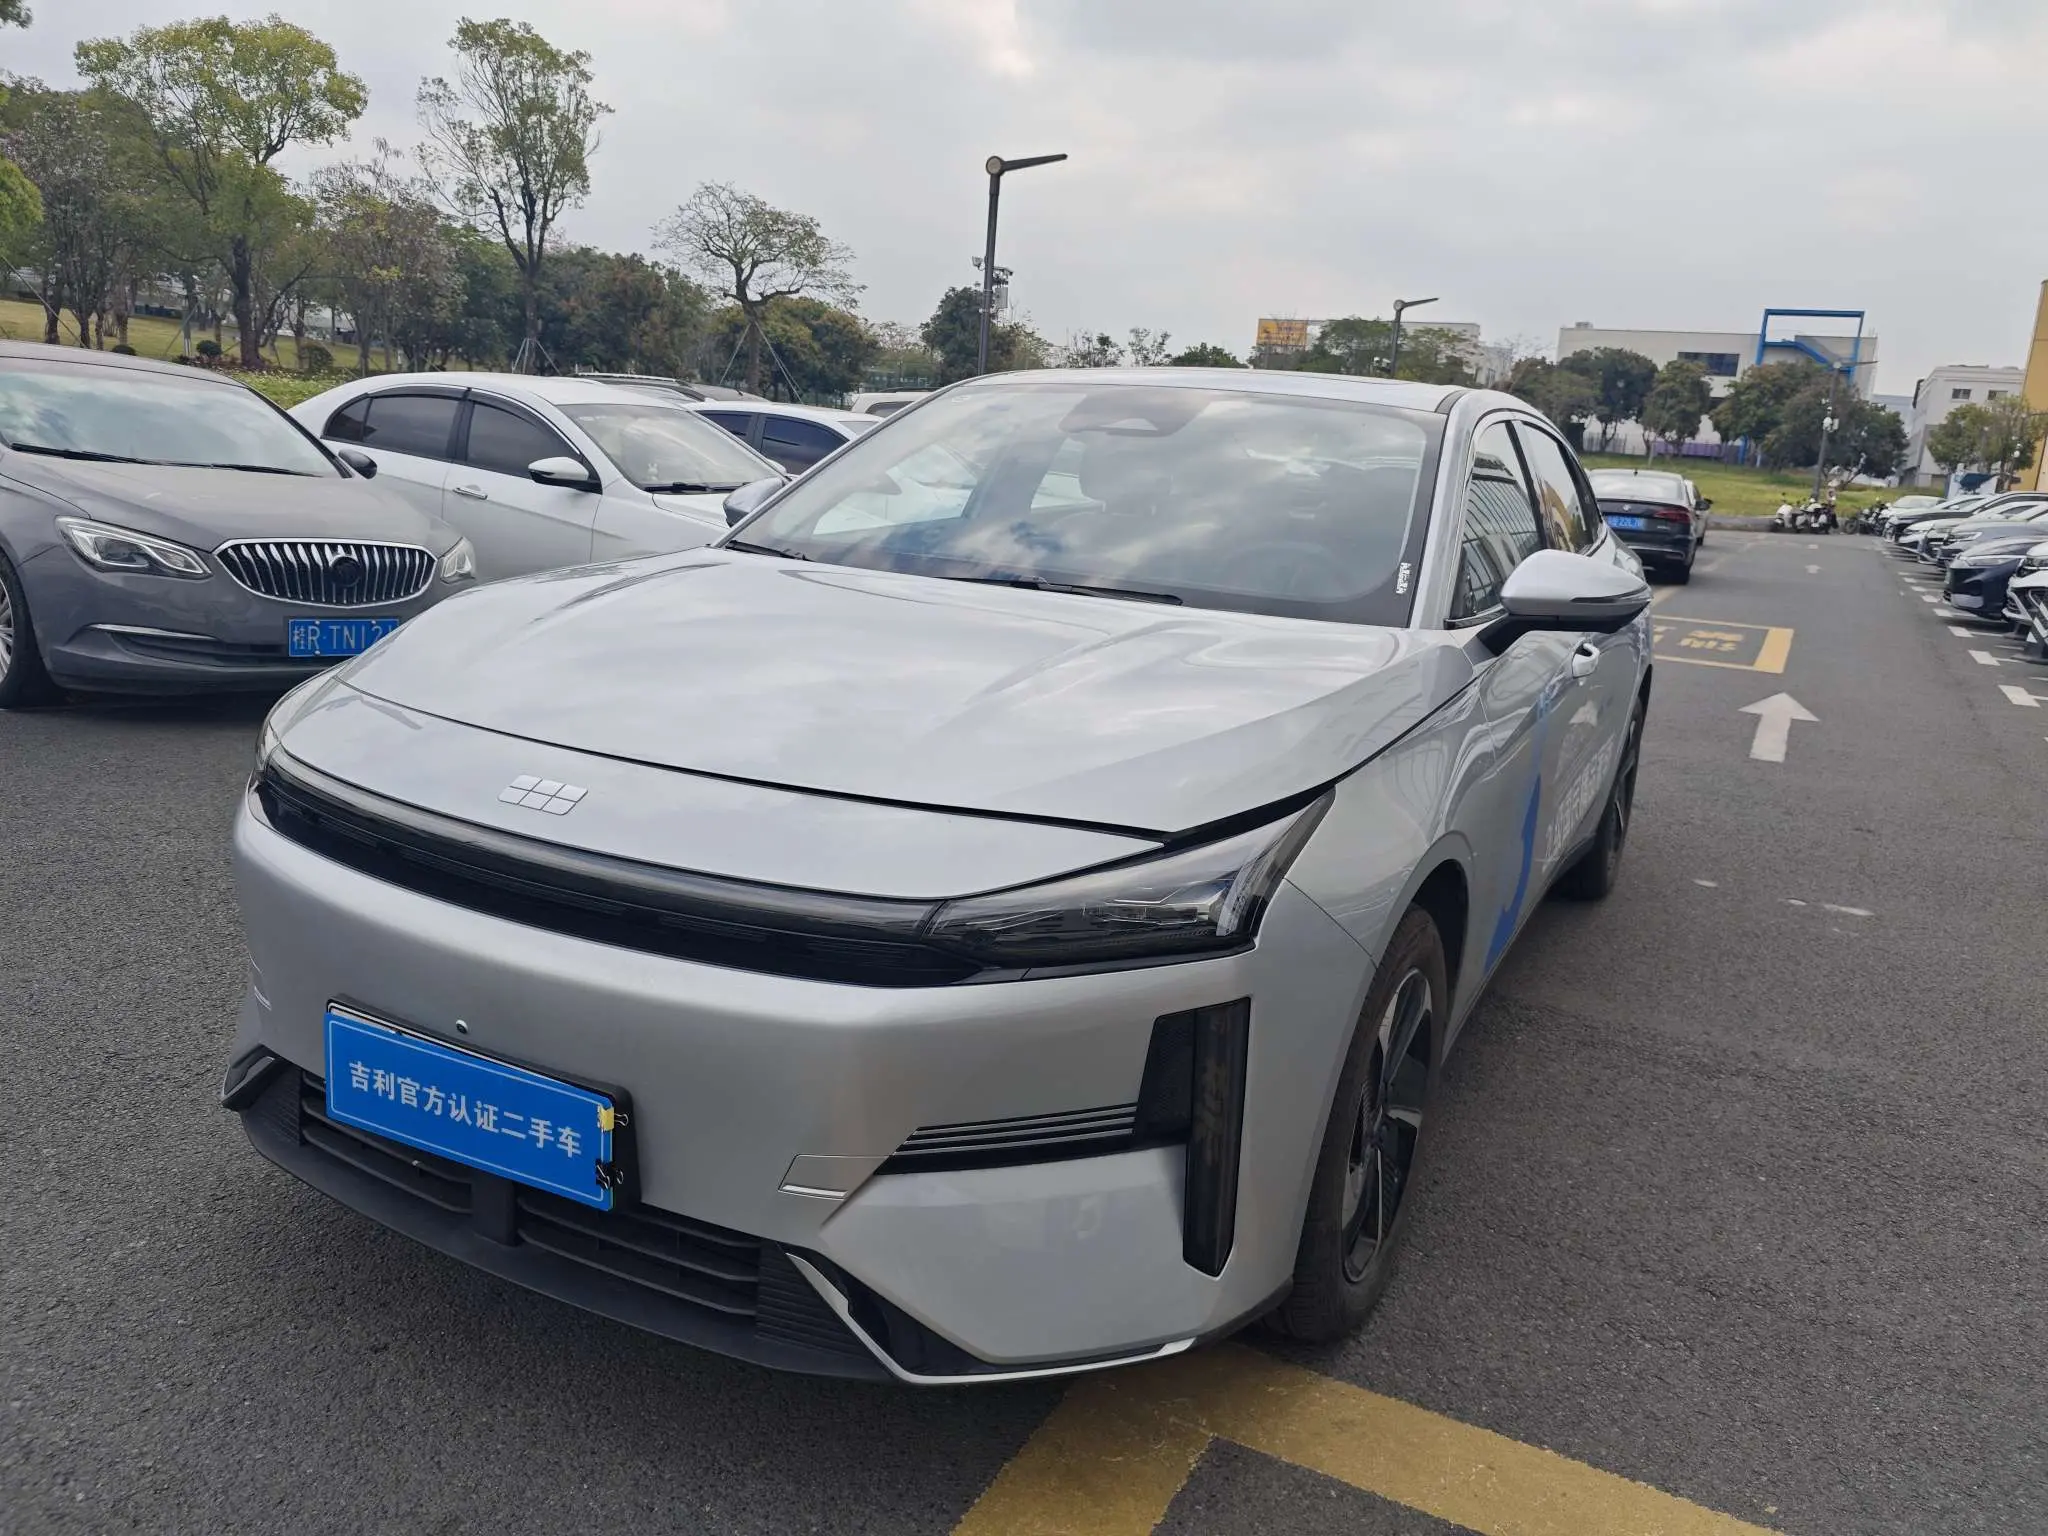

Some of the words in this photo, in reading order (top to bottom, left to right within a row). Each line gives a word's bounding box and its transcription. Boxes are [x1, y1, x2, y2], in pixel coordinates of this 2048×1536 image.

[293, 624, 394, 651] 桂R·TN12
[349, 1060, 582, 1158] 吉利官方认证二手车
